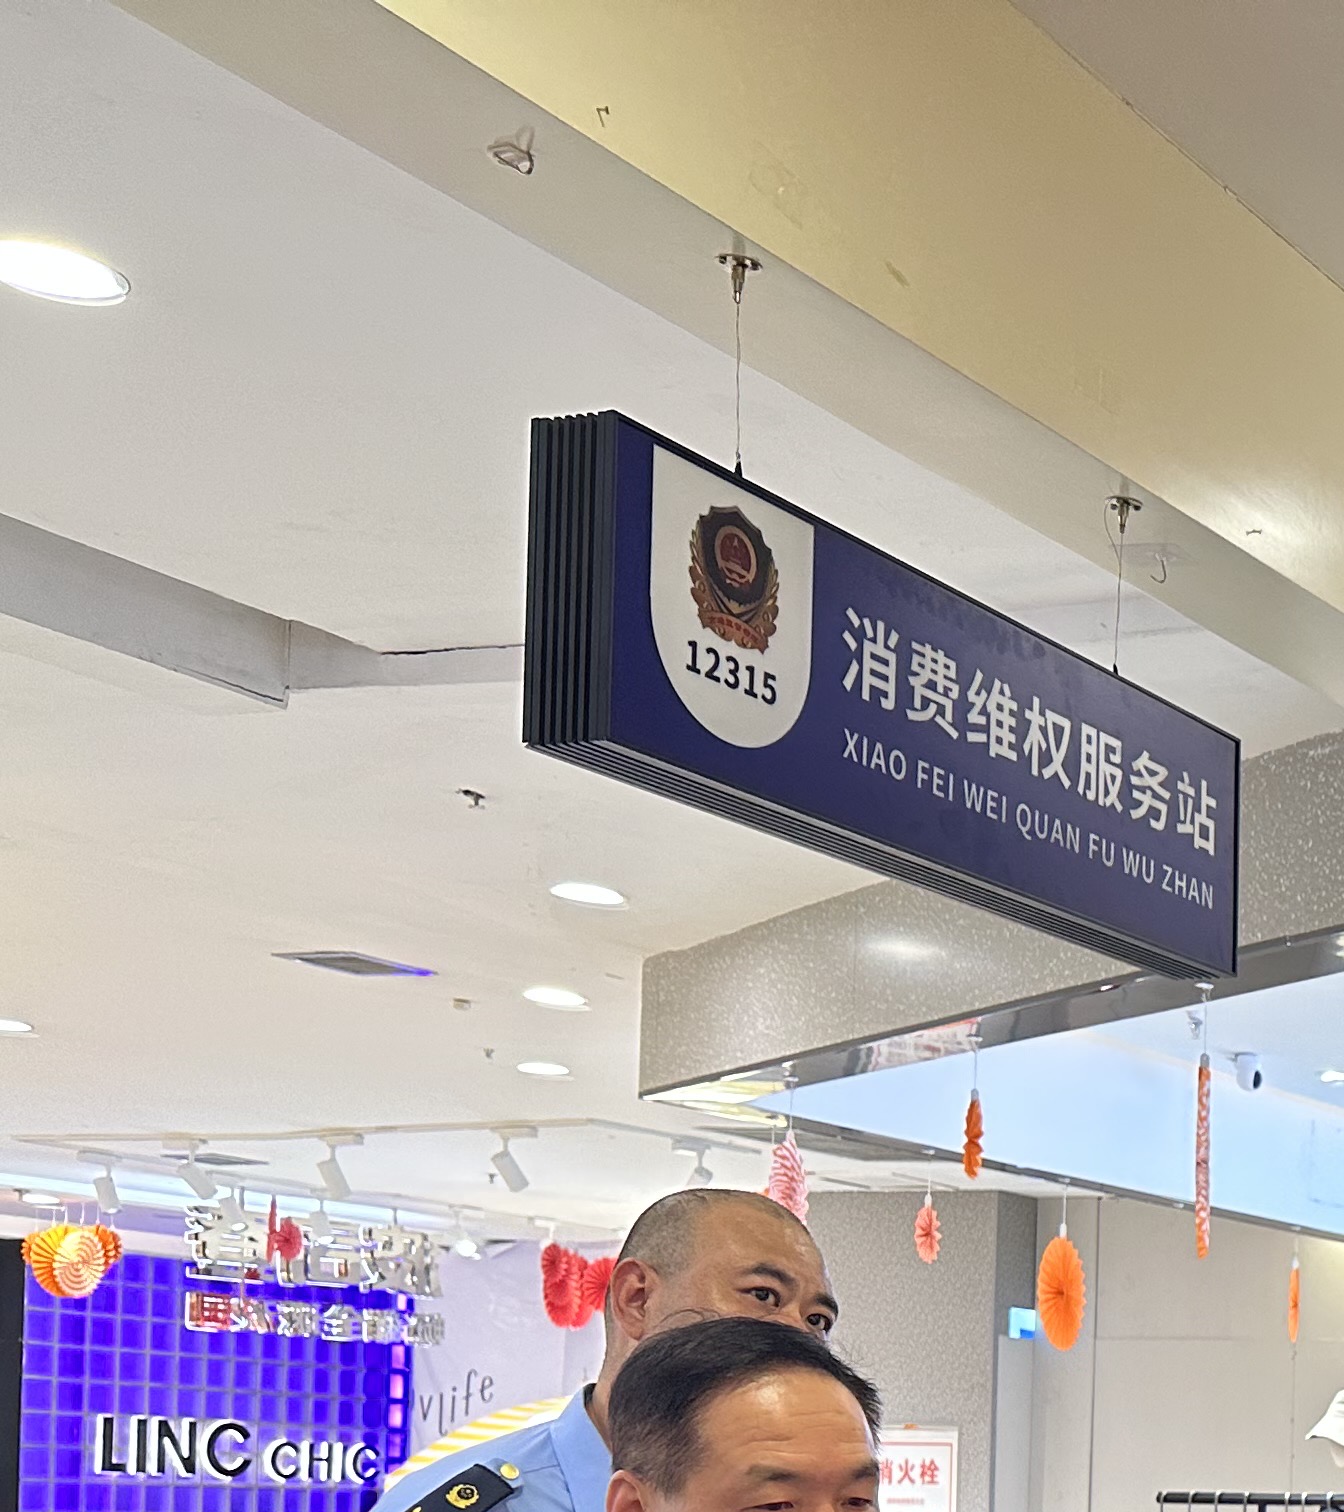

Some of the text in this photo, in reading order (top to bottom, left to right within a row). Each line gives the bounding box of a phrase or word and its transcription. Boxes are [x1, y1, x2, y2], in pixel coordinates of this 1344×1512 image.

[686, 640, 777, 705] 12315
[841, 606, 1217, 857] 消费维权服务站
[842, 728, 1214, 910] XIAO FEI WEI QUAN FU WU ZHAN
[94, 1414, 380, 1484] LINC CHIC
